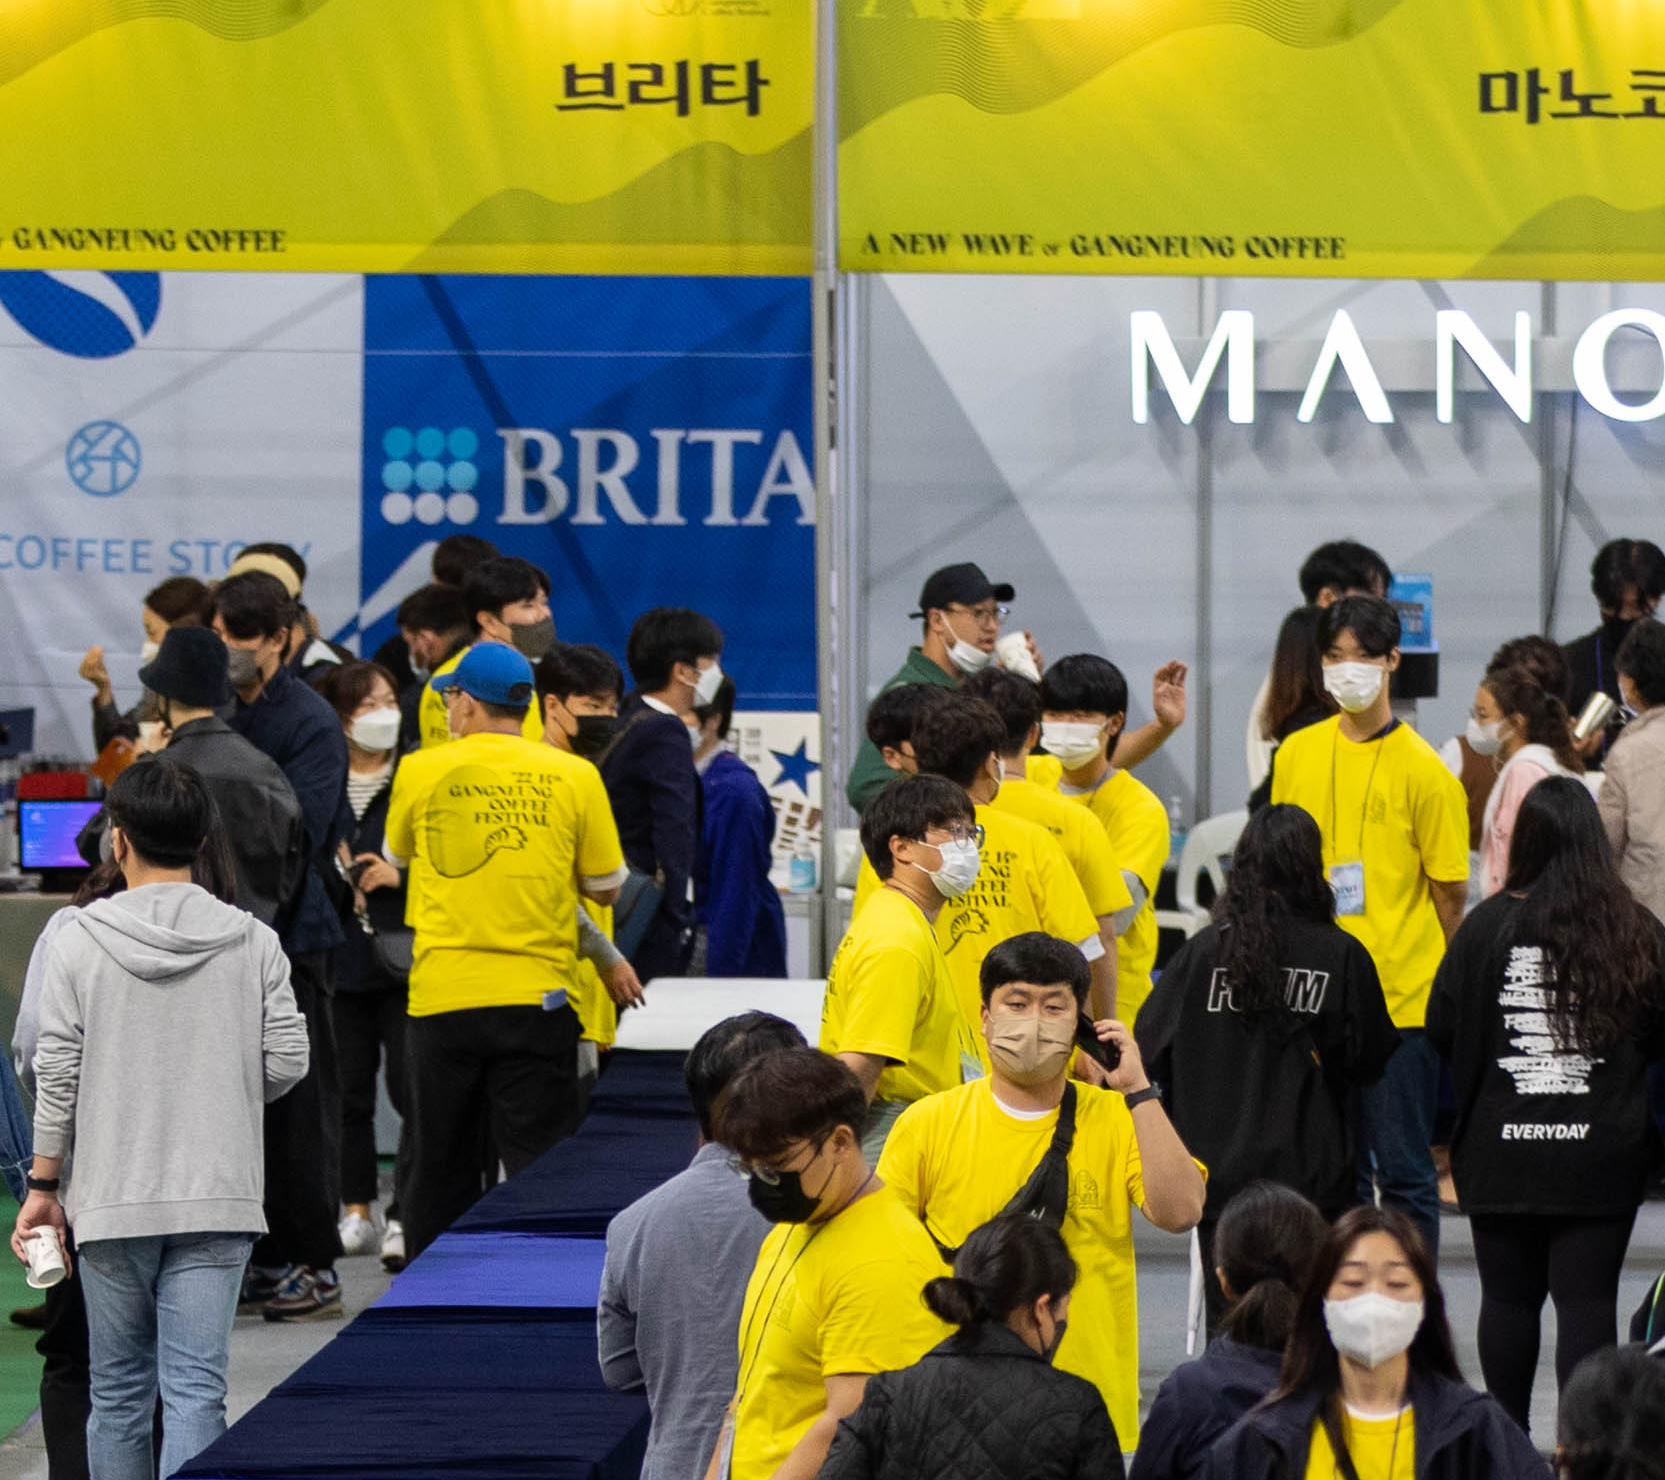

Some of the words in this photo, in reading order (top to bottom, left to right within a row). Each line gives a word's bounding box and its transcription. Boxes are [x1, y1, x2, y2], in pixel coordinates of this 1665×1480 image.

[556, 58, 771, 117] 브리타
[11, 225, 177, 253] GANGNEUNG
[184, 227, 288, 254] COFFEE
[861, 232, 880, 256] A
[889, 232, 950, 257] NEW
[962, 233, 1035, 258] WAVE
[1069, 233, 1236, 260] GANGNEUNG
[1244, 235, 1347, 261] COFFEE
[497, 426, 815, 527] BRITA
[169, 540, 312, 574] STOY
[449, 783, 553, 798] GANGNEUNG
[488, 797, 552, 814] COFFEE
[474, 811, 551, 828] FESTIVAL
[948, 894, 1012, 909] ESTIVAL
[1501, 1123, 1590, 1140] EVERYDAY
